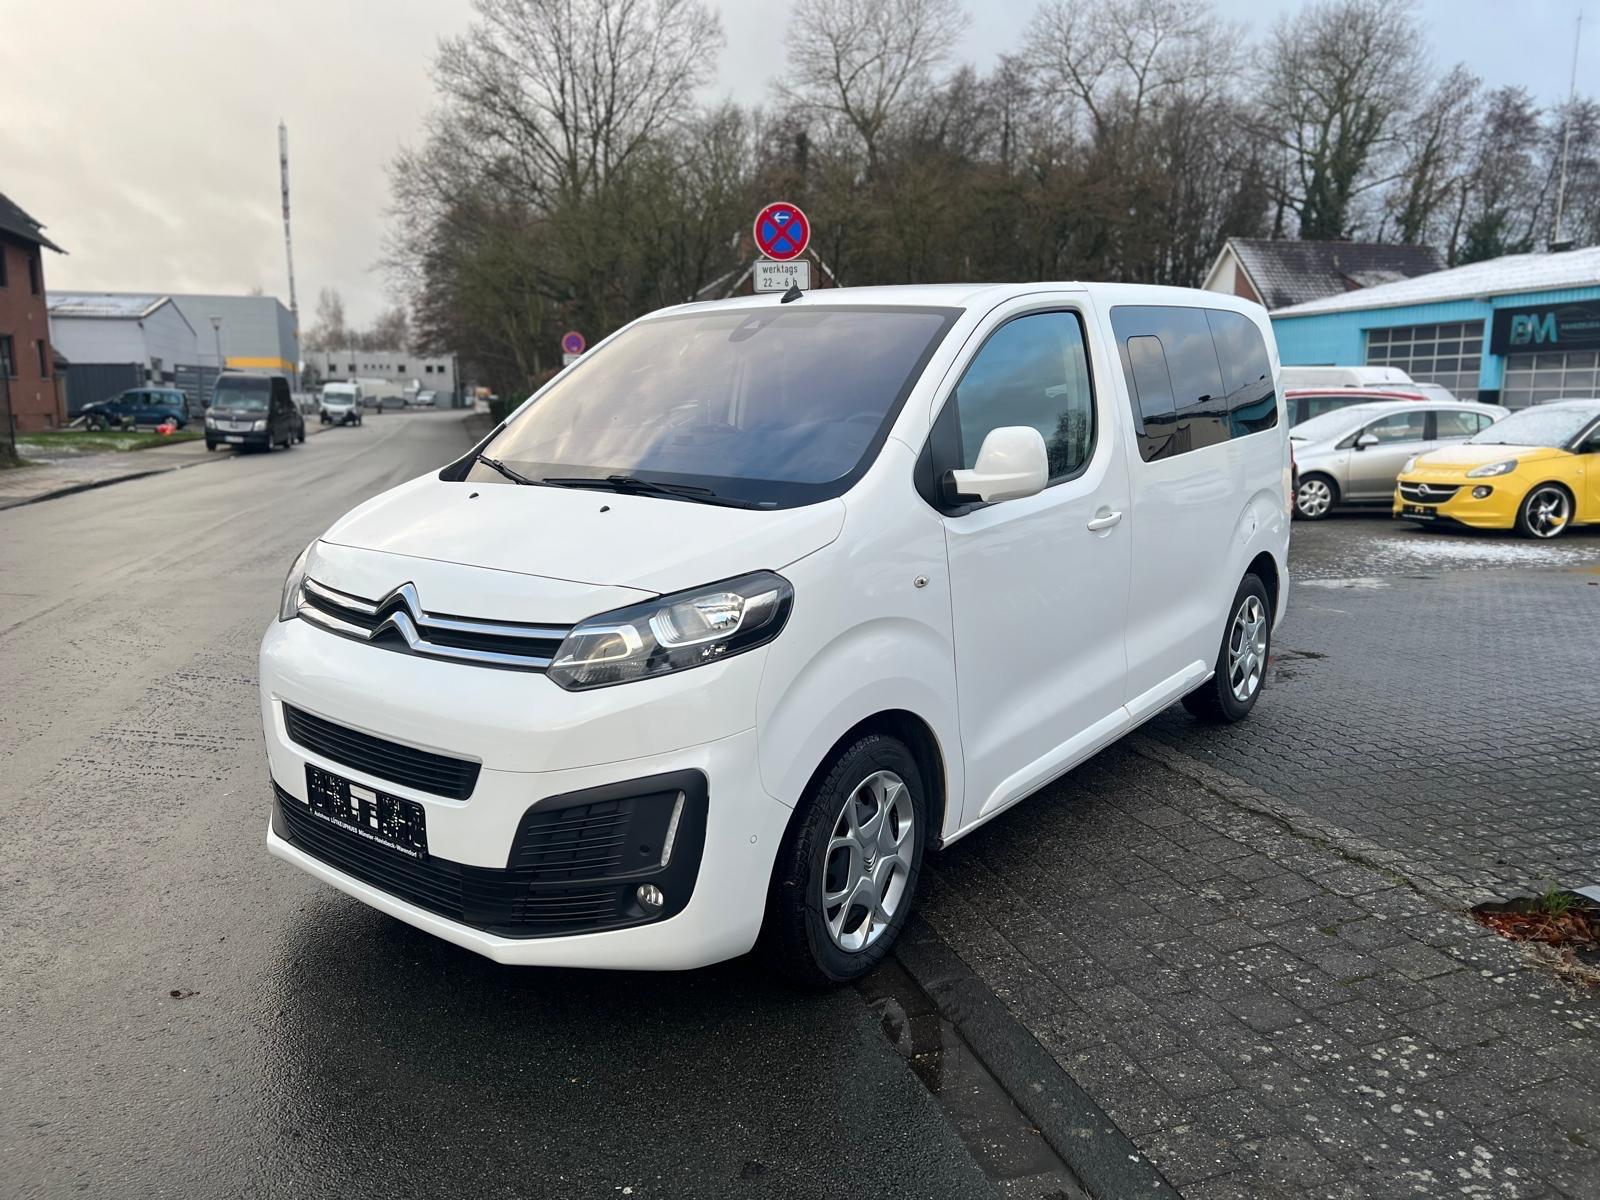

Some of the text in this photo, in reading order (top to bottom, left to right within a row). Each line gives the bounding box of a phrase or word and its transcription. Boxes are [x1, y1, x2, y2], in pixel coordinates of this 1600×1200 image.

[762, 264, 798, 276] werktags
[763, 278, 773, 288] 22
[784, 278, 789, 287] 6
[792, 277, 798, 286] h
[1509, 312, 1558, 345] BM
